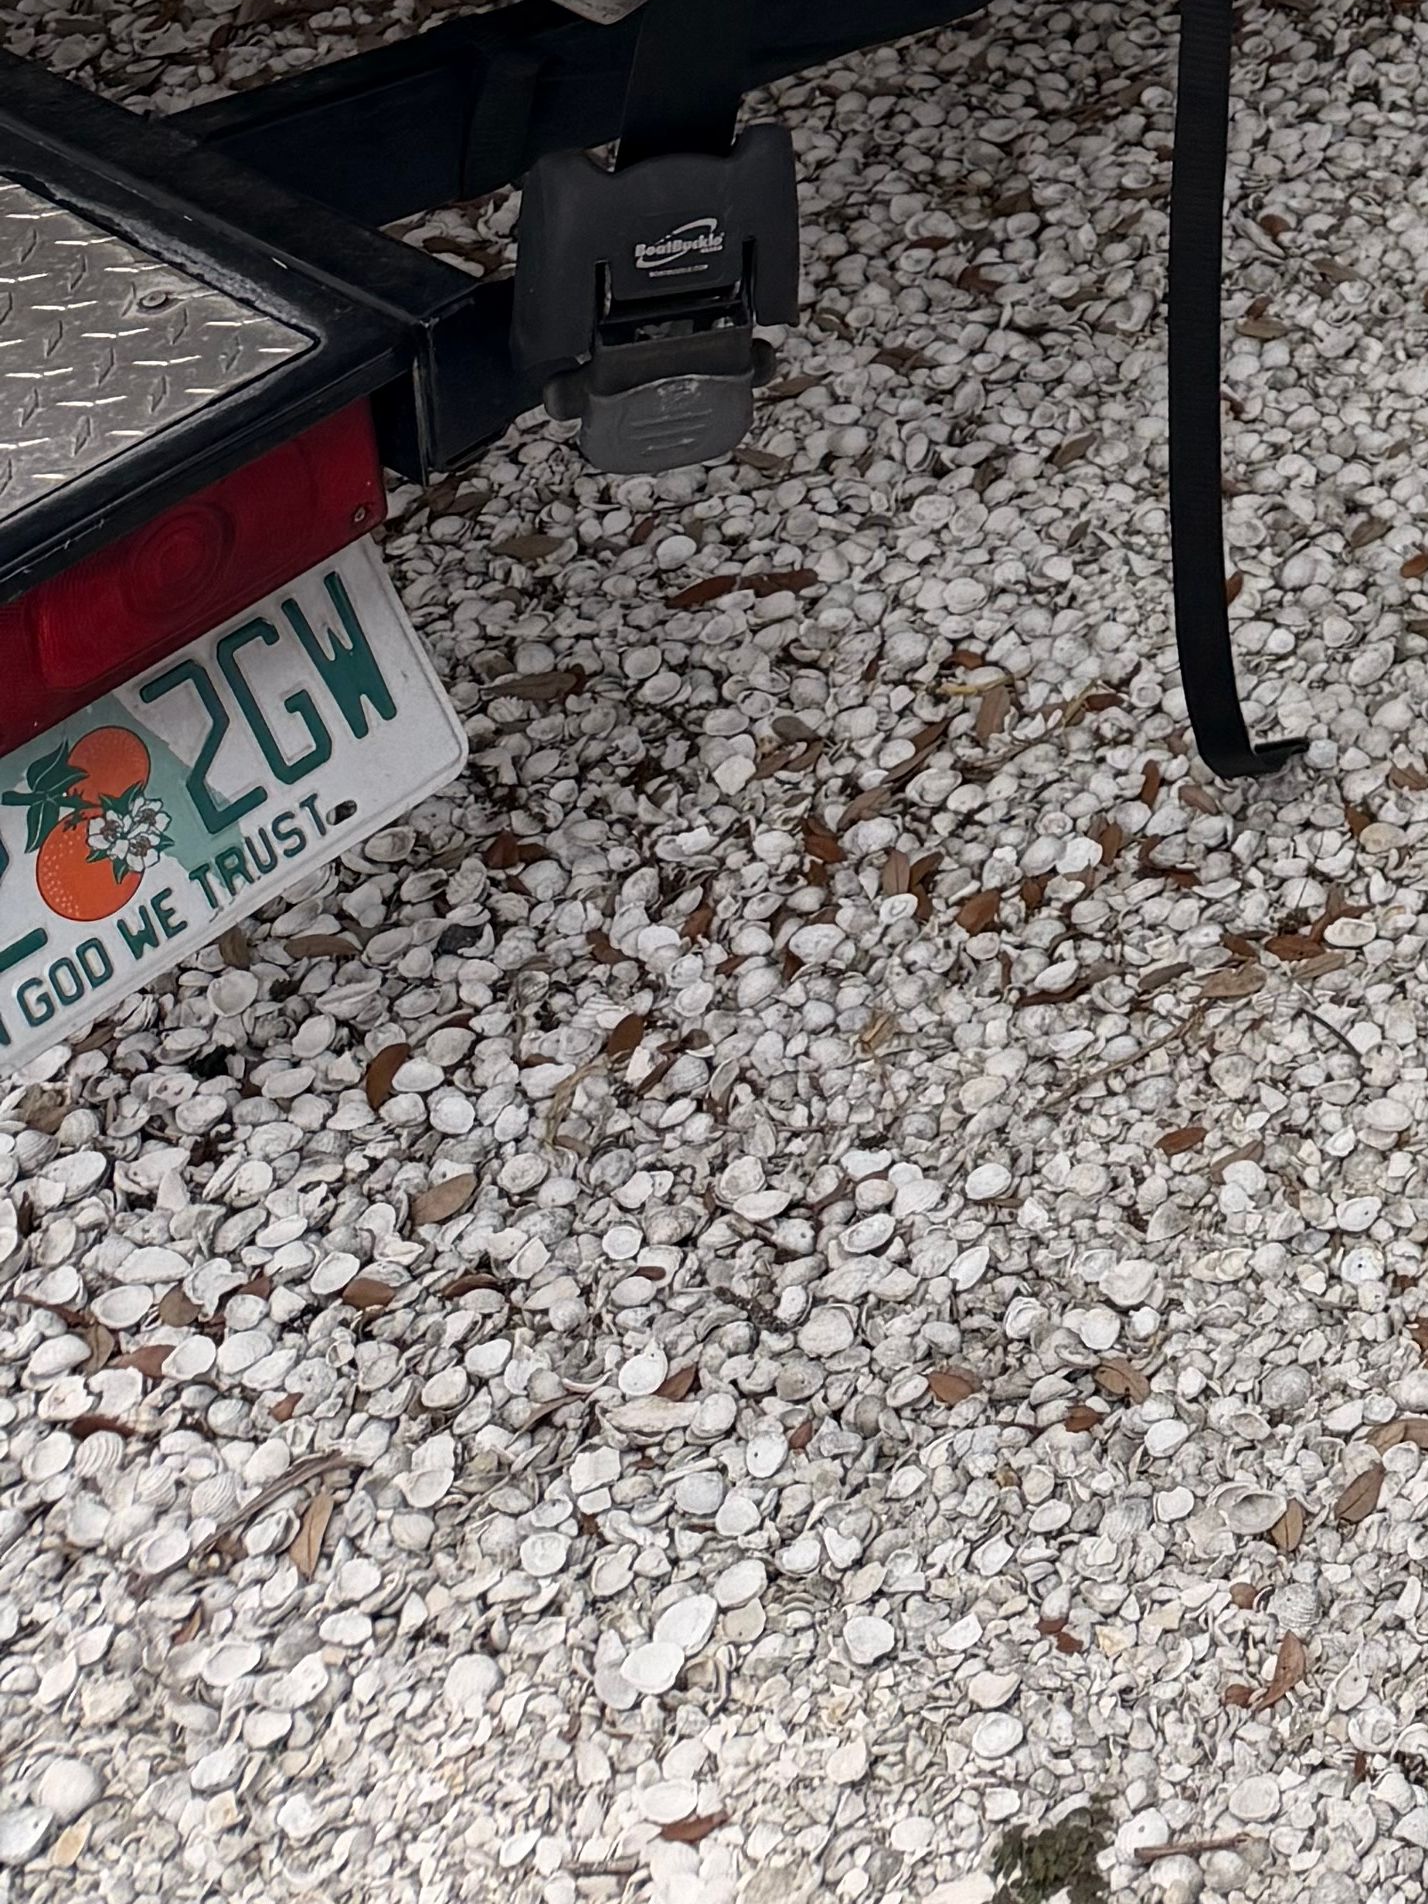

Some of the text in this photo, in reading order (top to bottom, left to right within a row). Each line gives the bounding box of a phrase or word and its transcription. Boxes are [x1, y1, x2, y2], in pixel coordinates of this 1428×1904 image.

[140, 570, 397, 835] 2GW
[16, 936, 113, 1028] GOD
[117, 887, 188, 960] WE
[190, 793, 330, 910] TRUST
